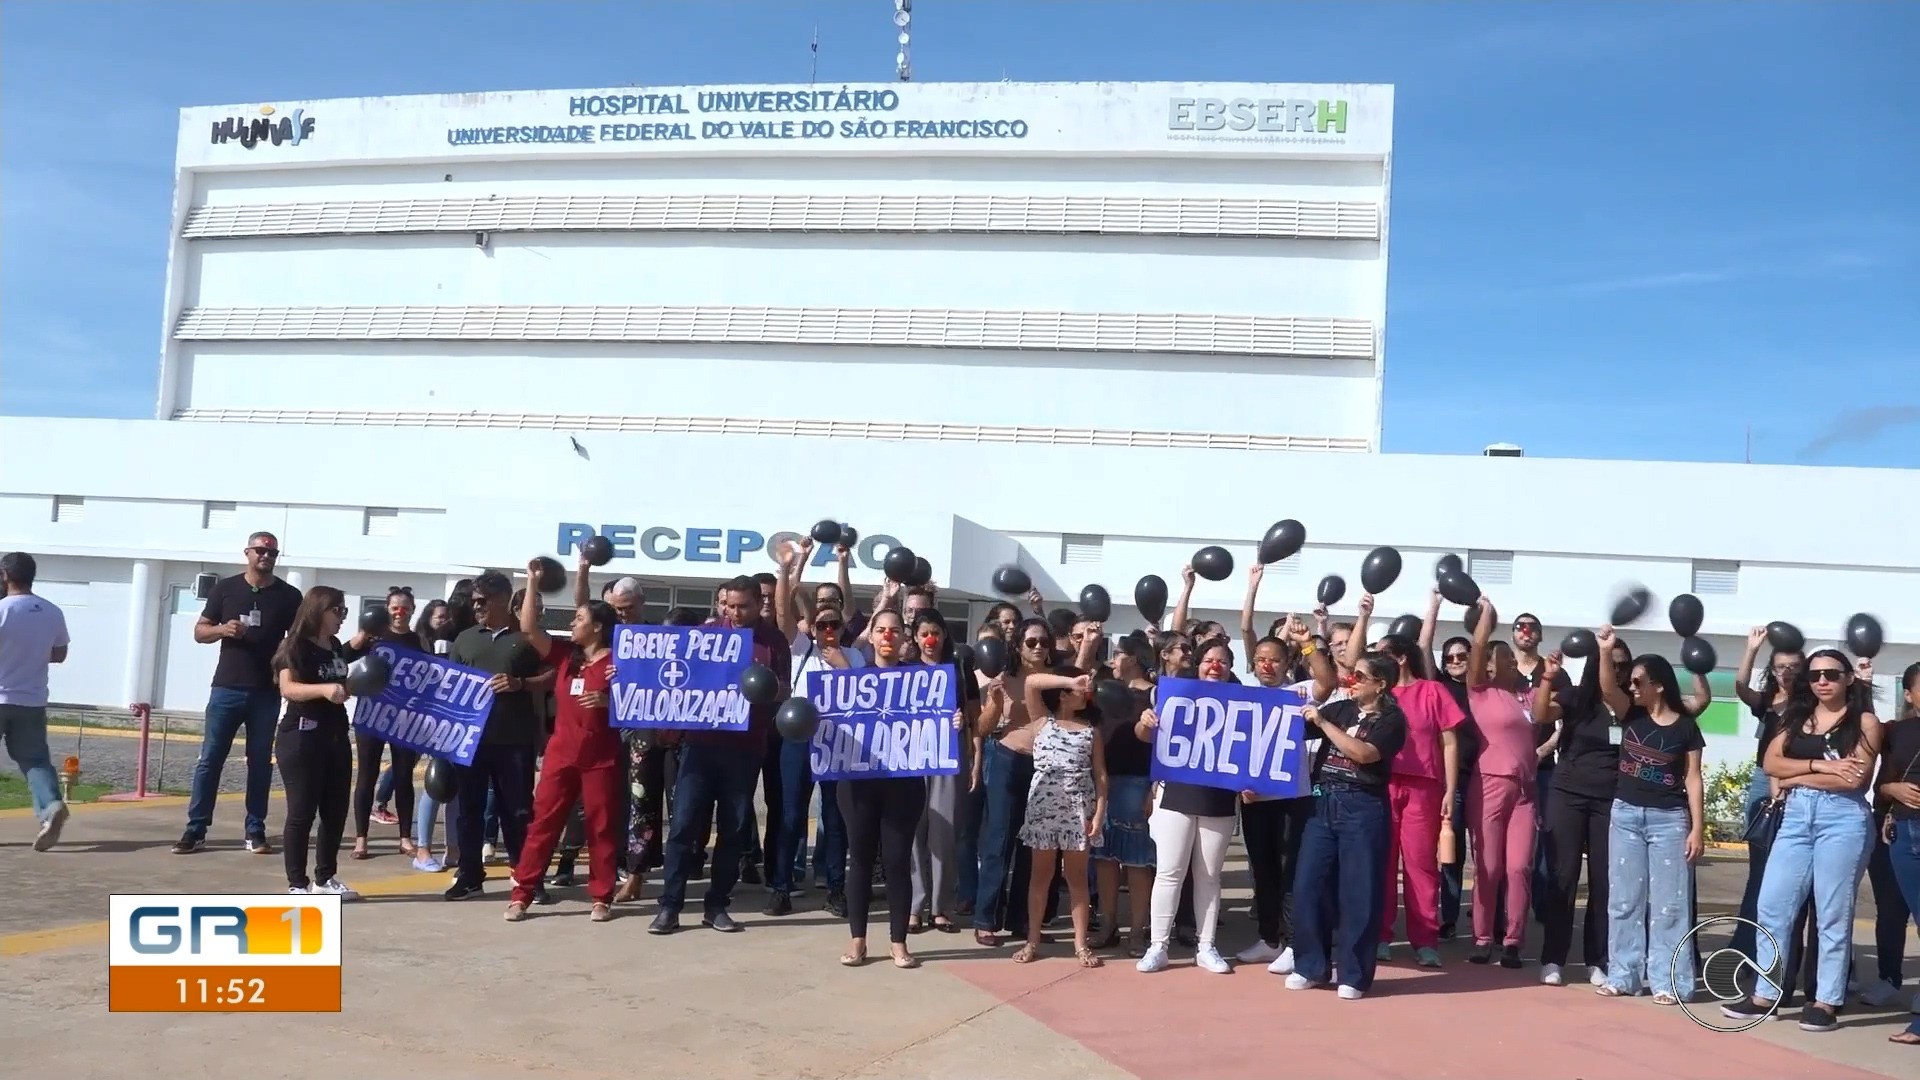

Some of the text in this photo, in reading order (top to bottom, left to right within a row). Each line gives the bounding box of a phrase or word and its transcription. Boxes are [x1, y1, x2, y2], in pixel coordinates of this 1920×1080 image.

[569, 85, 899, 116] HOSPITAL UNIVERSITÁRIO
[1168, 97, 1348, 133] EBSERH
[448, 116, 1029, 146] UNIVERSIDADE FEDERAL DO VALE DO SÃO FRANCISCO
[618, 629, 742, 663] GREVE PELA
[612, 683, 750, 728] VALORIZAÇÃO
[814, 670, 948, 714] JUSTIÇA
[354, 696, 481, 758] DIGNIDADE
[810, 717, 958, 775] SALARIAL
[1156, 696, 1303, 782] GREVE
[1620, 760, 1676, 786] adidas
